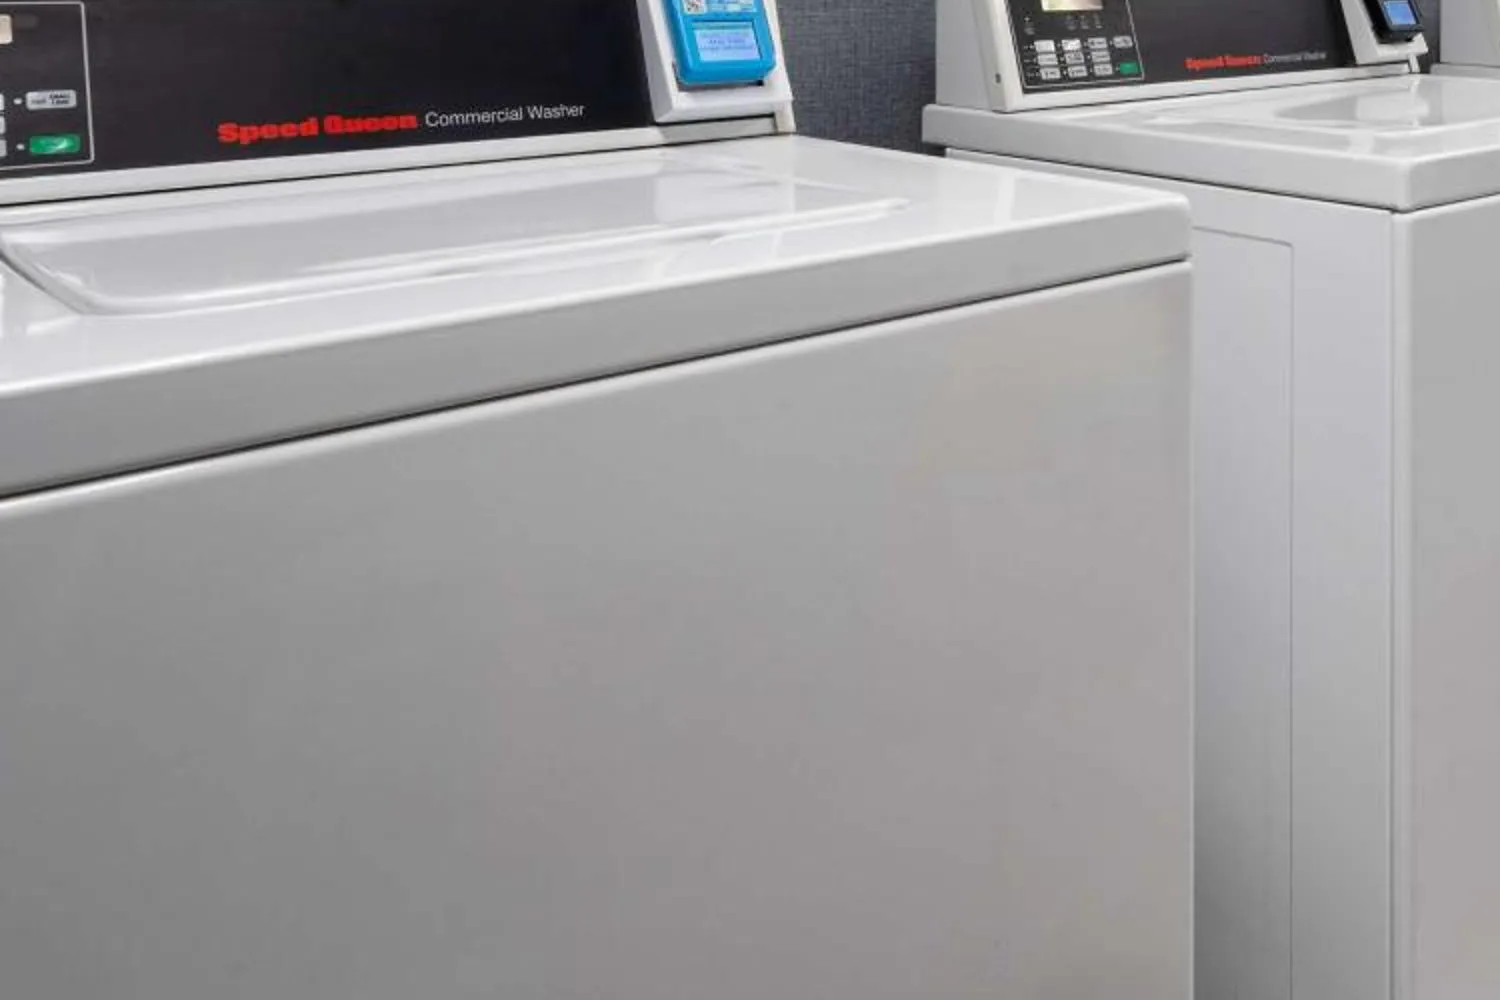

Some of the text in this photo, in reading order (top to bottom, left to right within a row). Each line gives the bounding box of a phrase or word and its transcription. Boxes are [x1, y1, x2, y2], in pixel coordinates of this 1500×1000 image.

[216, 103, 585, 145] Speed Queen Commercial Washer
